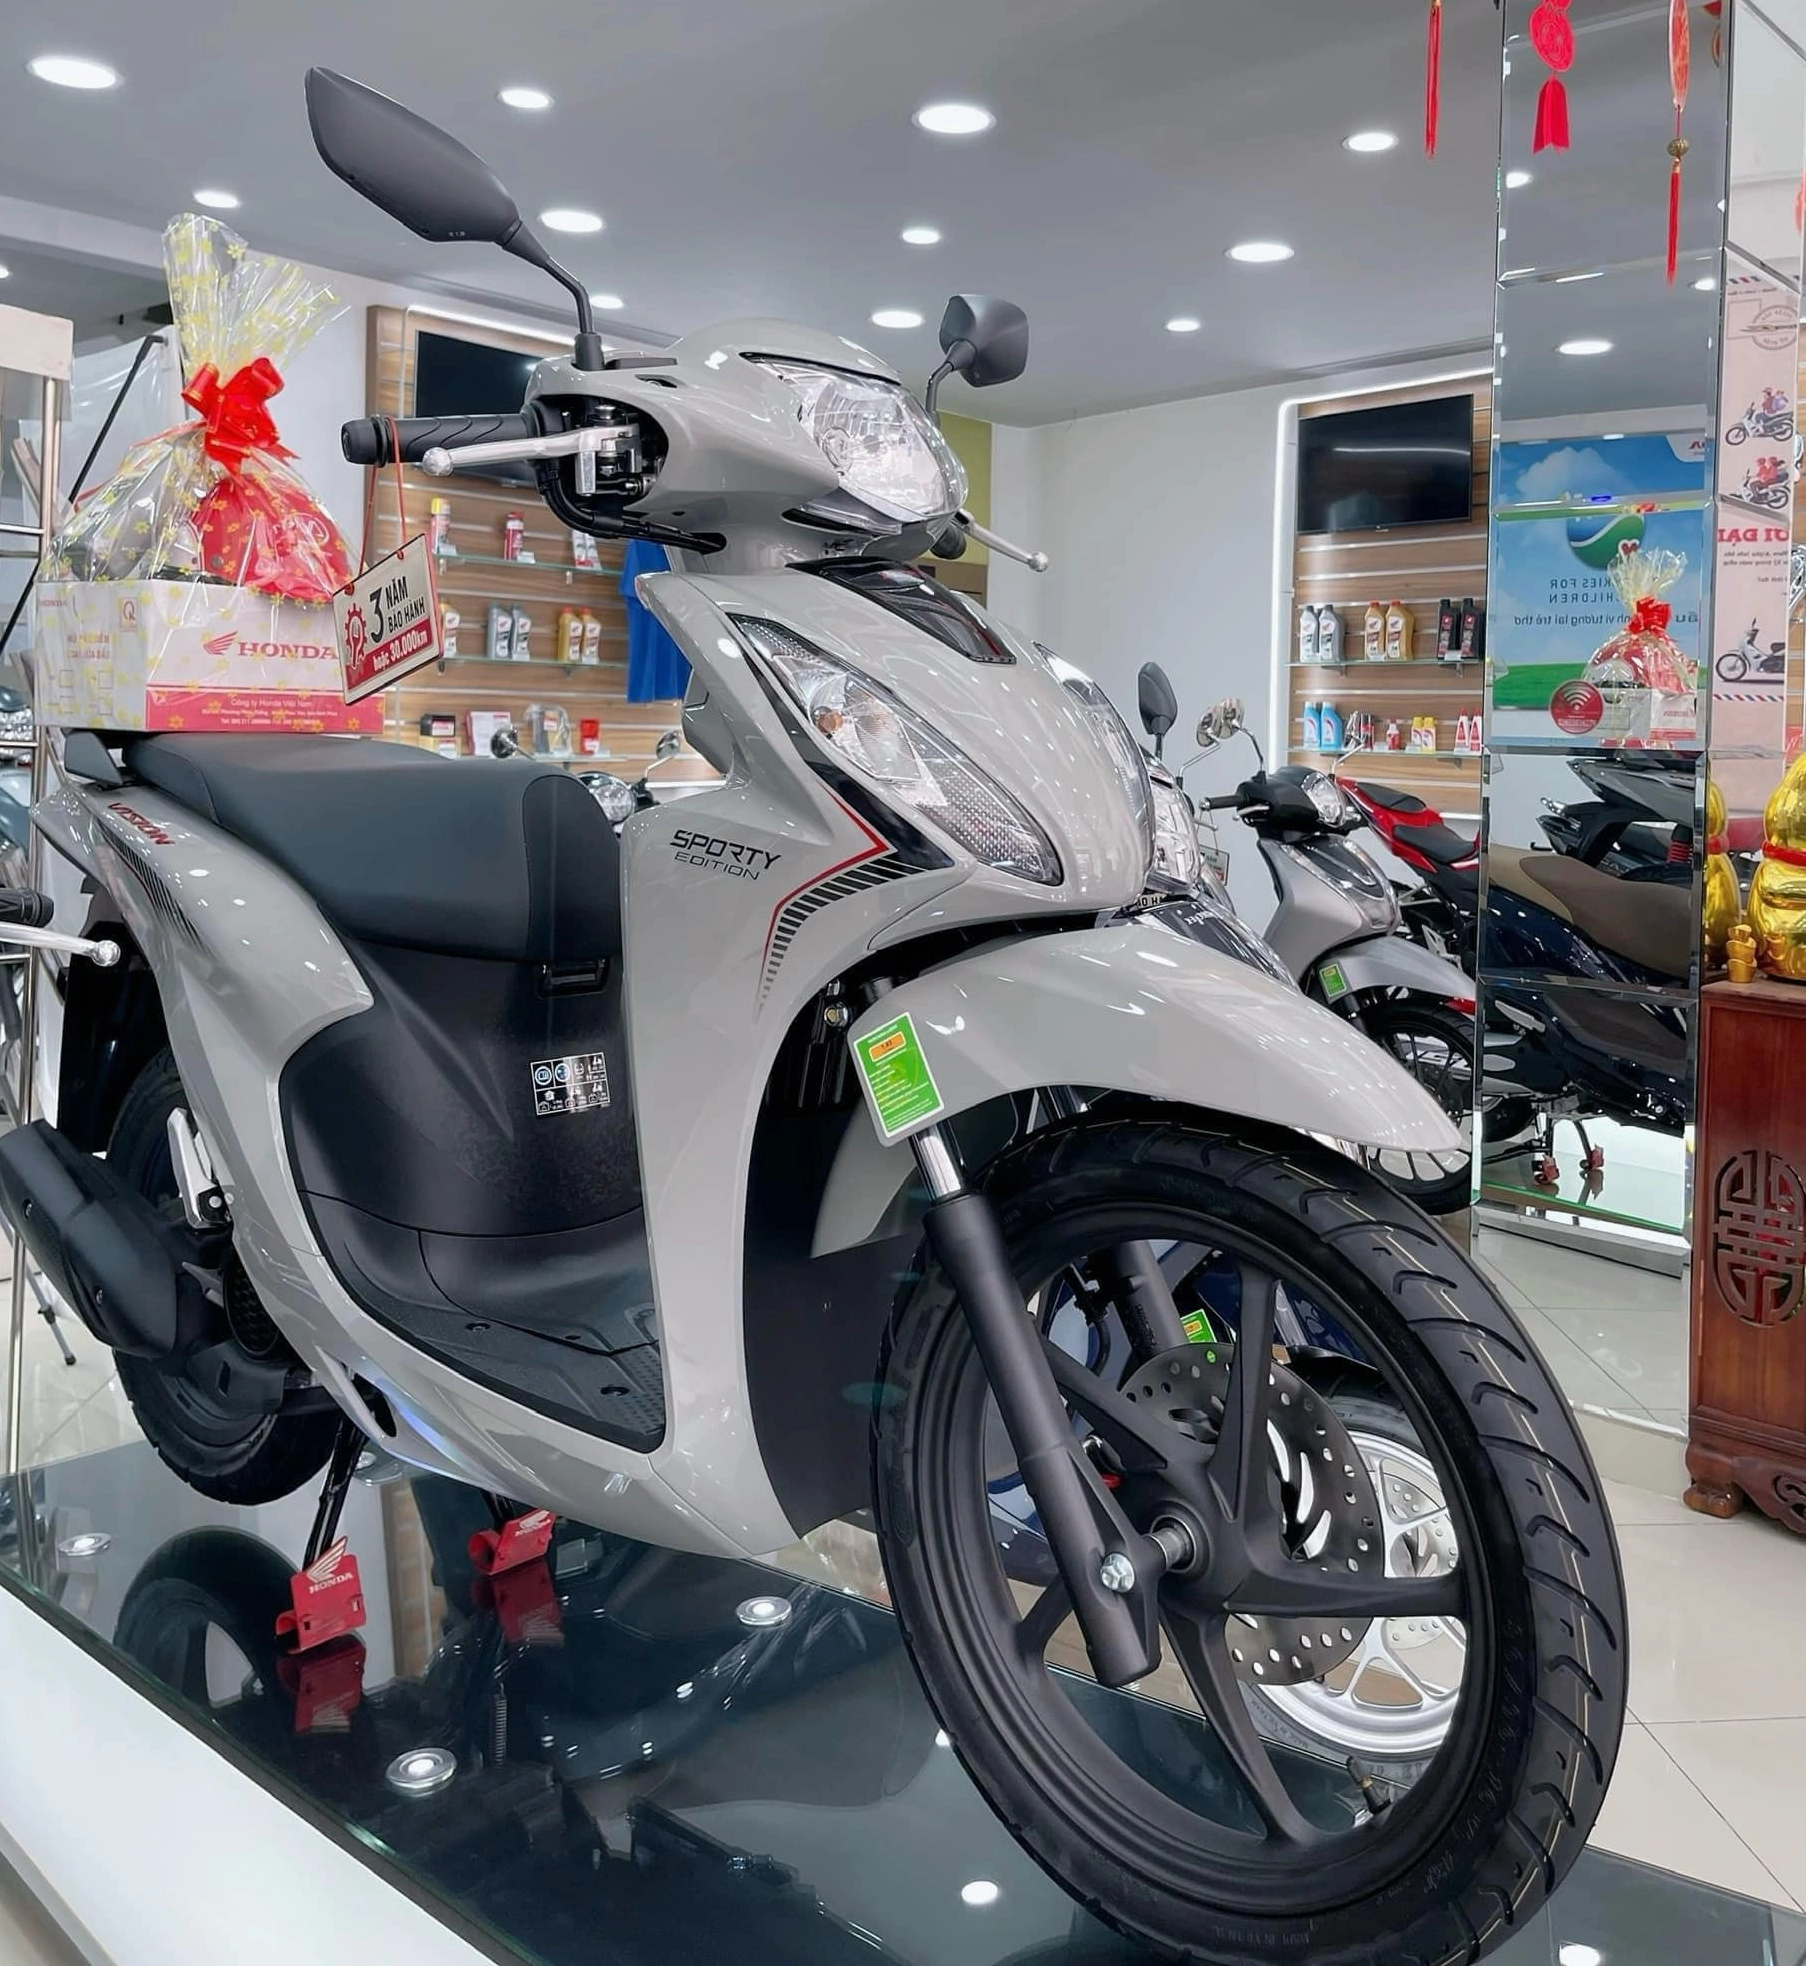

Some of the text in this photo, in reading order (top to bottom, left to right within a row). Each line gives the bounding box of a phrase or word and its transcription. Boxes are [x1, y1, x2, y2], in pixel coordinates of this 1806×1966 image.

[385, 576, 408, 610] NĂM
[369, 587, 384, 643] 3
[388, 597, 426, 633] BẢO HÀNH
[238, 642, 340, 659] HONDA
[372, 651, 391, 671] hoặc
[230, 699, 250, 708] Công
[251, 700, 258, 709] ty
[297, 700, 313, 708] Nam
[670, 830, 781, 869] SPORTY
[674, 851, 760, 880] EDITION
[309, 1572, 353, 1594] HONDA
